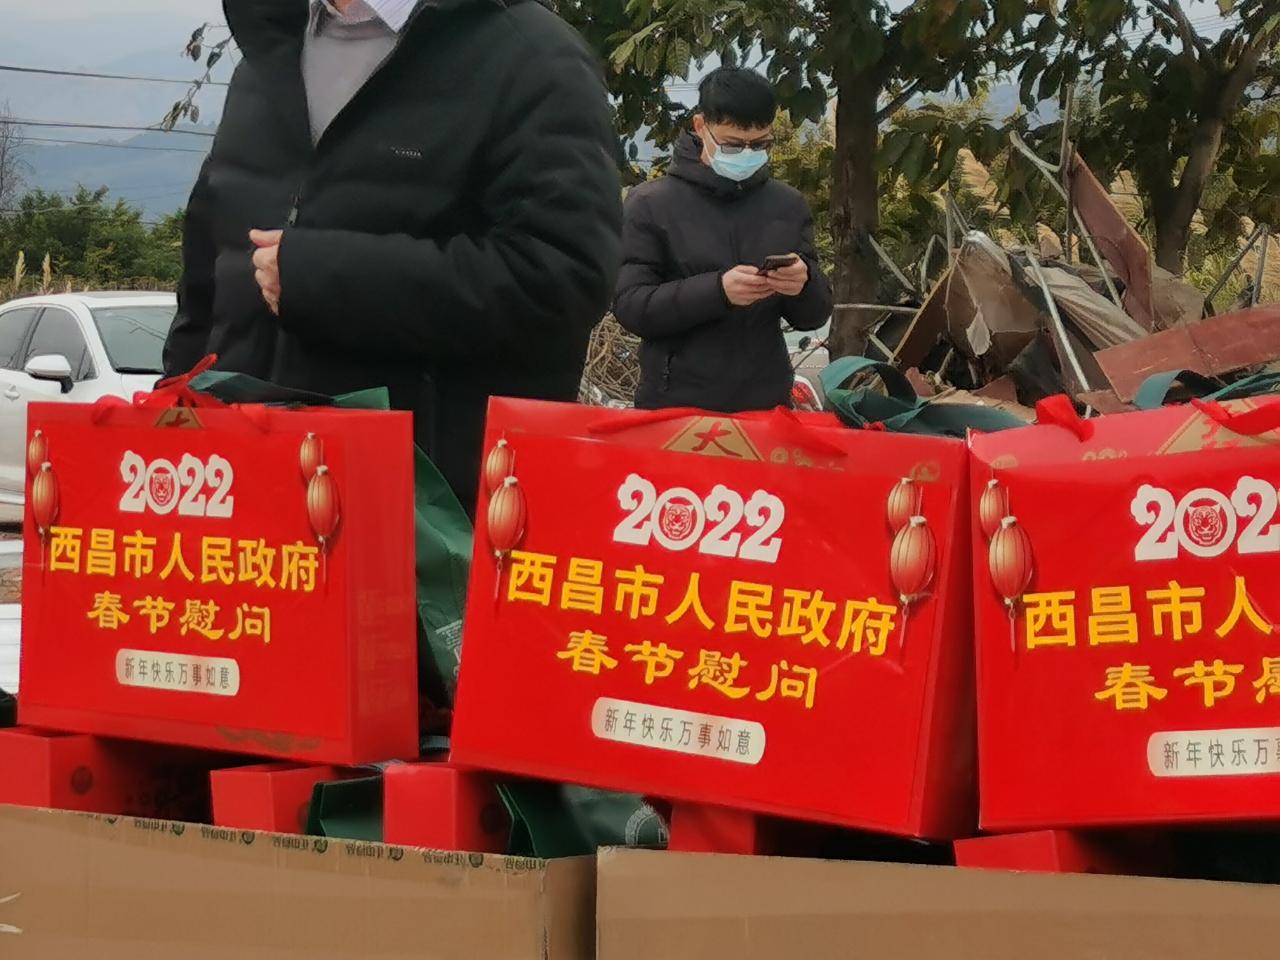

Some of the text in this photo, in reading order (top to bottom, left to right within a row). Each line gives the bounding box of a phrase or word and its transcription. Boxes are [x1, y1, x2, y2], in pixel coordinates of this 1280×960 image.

[119, 450, 234, 518] 2022
[613, 473, 785, 563] 2022
[1130, 475, 1280, 561] 202
[49, 526, 319, 592] 西昌市人民政府
[87, 590, 271, 643] 春节慰问
[507, 550, 898, 656] 西昌市人民政府
[125, 657, 230, 689] 新年快乐万事如意
[556, 629, 818, 709] 春节慰问
[604, 706, 752, 756] 新年快乐万事如意
